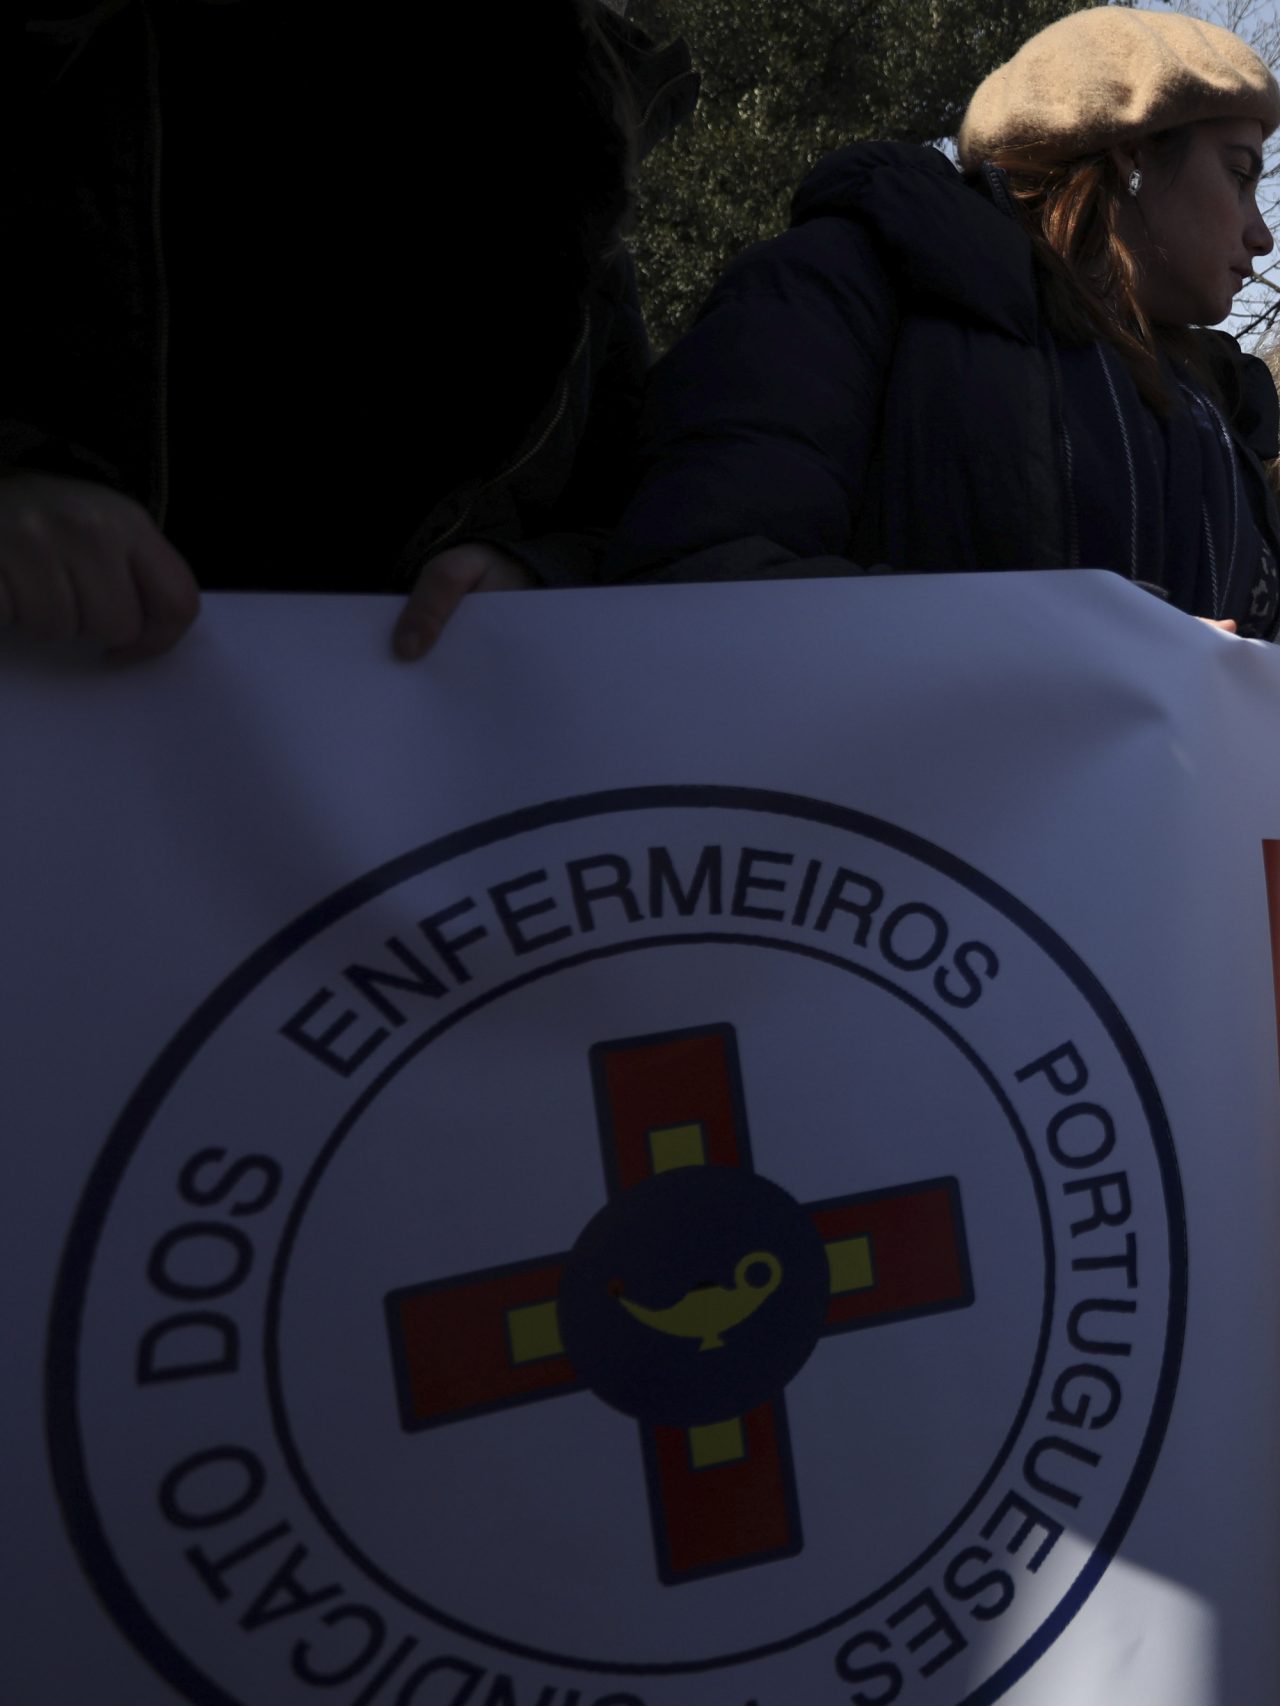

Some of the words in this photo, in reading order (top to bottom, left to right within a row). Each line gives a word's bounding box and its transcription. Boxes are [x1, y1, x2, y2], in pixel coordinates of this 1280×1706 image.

[136, 1146, 284, 1386] DOS
[280, 844, 1001, 1077] ENFERMEIROS
[835, 1040, 1140, 1706] PORTUGUESES
